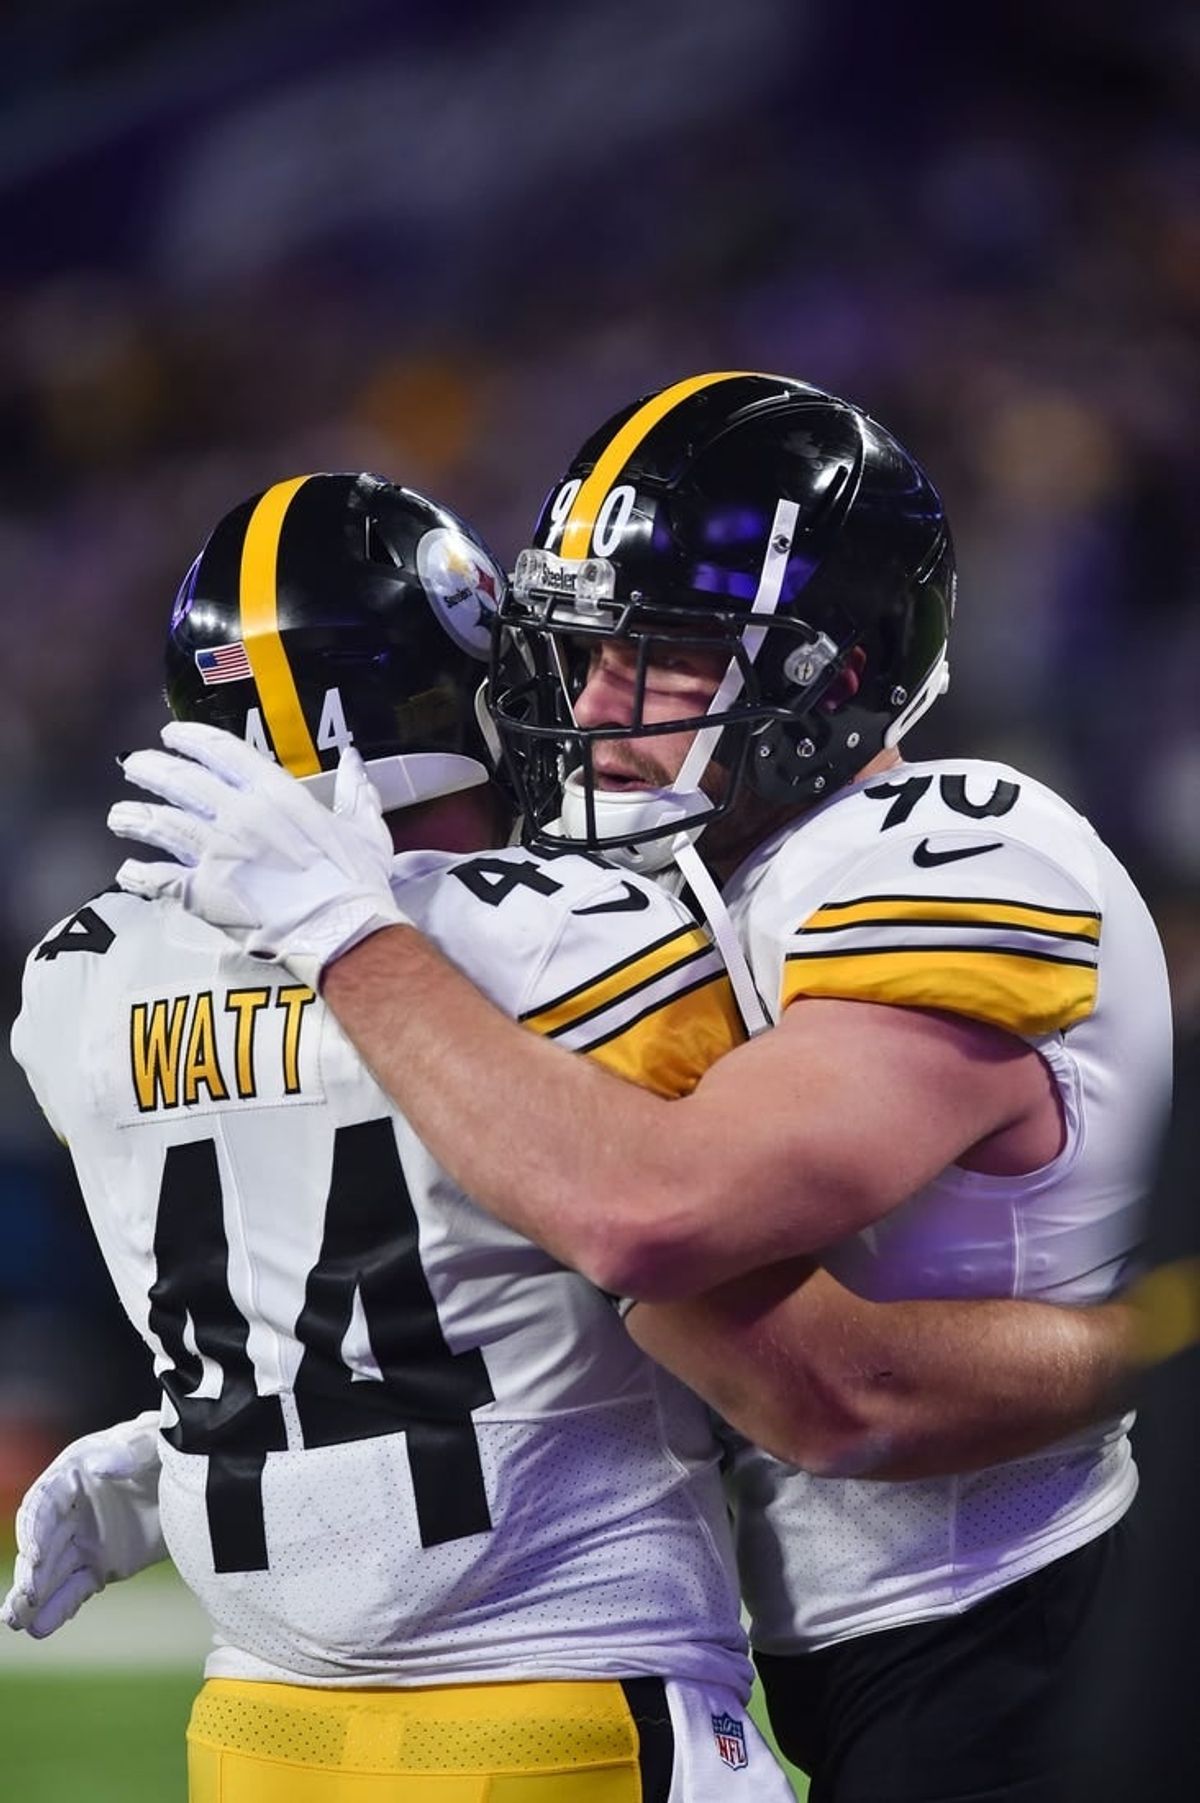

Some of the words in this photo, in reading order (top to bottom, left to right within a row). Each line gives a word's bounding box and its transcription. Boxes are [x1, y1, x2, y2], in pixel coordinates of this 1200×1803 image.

[544, 479, 636, 557] 90
[130, 984, 317, 1113] WATT
[148, 1116, 496, 1574] 44
[715, 1734, 746, 1766] NFL
